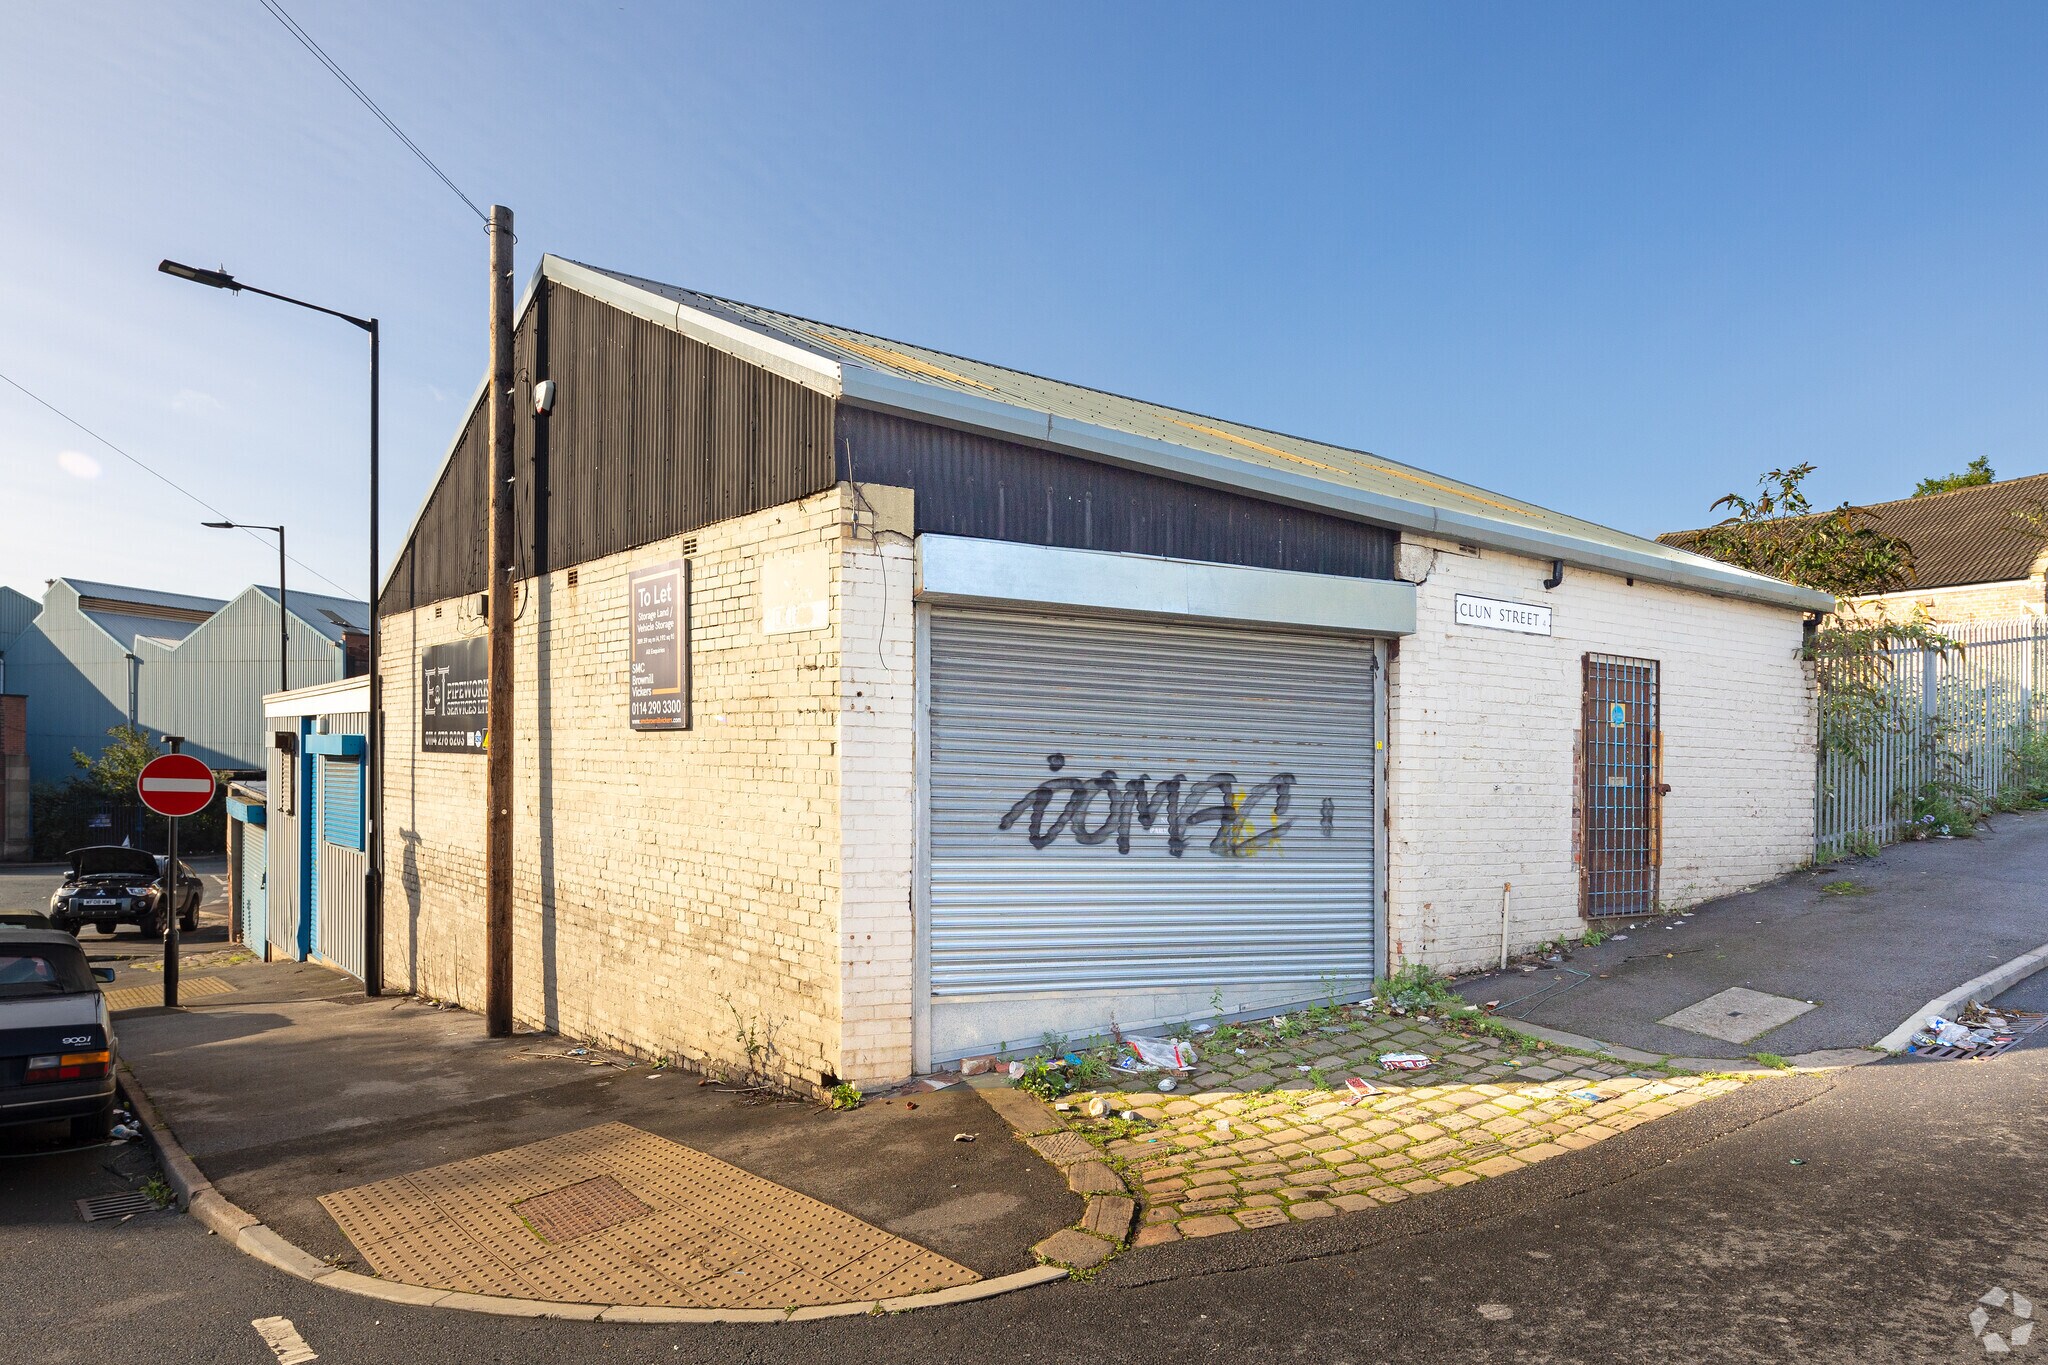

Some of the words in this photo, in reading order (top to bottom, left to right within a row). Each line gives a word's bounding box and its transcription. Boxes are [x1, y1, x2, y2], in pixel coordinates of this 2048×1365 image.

[638, 587, 651, 607] To
[653, 582, 672, 604] Let
[638, 611, 656, 621] Storage
[656, 607, 669, 618] Land
[1460, 603, 1491, 619] CLUN
[1499, 608, 1539, 626] STREET
[637, 623, 655, 633] Vehicle
[654, 620, 675, 631] Storage
[631, 662, 646, 674] SMC
[631, 673, 654, 686] Brownill
[631, 686, 652, 697] Vickers
[446, 700, 477, 716] SERVICES
[631, 702, 647, 715] 0114
[647, 700, 661, 715] 290
[662, 699, 681, 714] 3300
